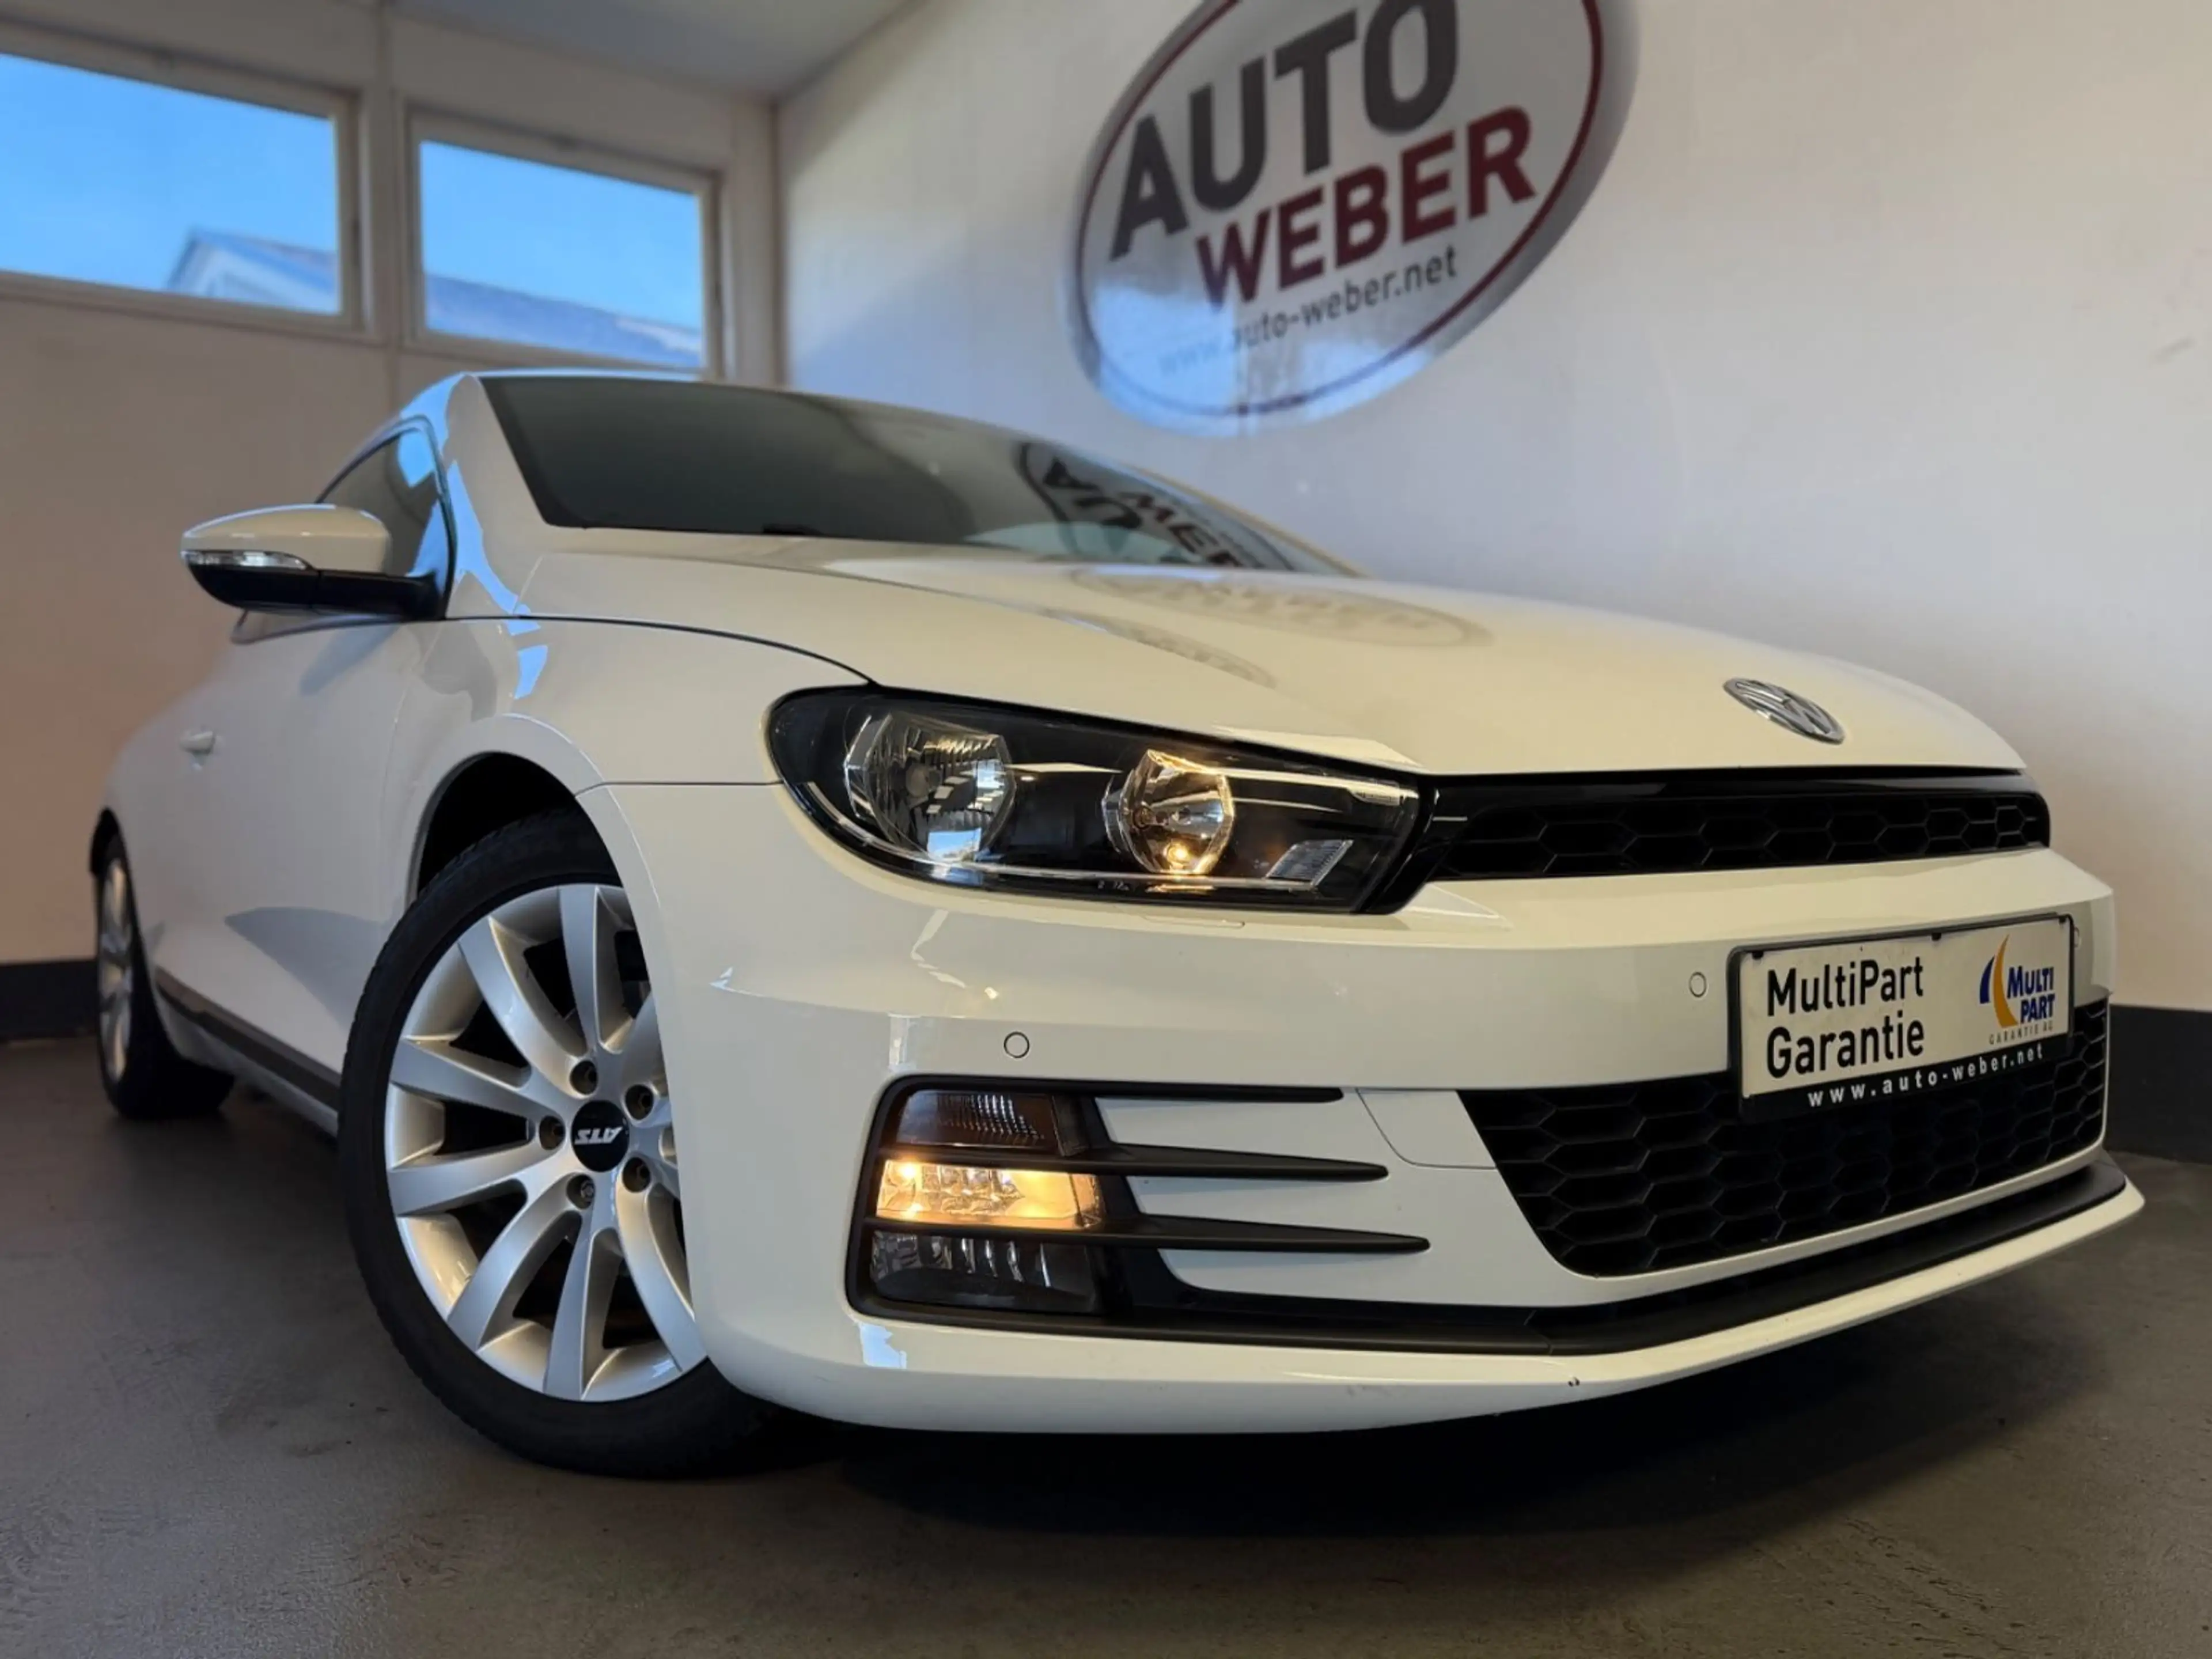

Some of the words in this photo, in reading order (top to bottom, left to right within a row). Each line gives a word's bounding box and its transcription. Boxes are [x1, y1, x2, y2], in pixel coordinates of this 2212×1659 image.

[1109, 0, 1457, 262] AUTO
[1195, 106, 1537, 313] WEBER
[1766, 956, 1924, 1017] MultiPart
[2020, 993, 2055, 1024] PART
[1766, 1010, 1925, 1078] Garantie
[1807, 1043, 2044, 1107] www.auto-weber.net
